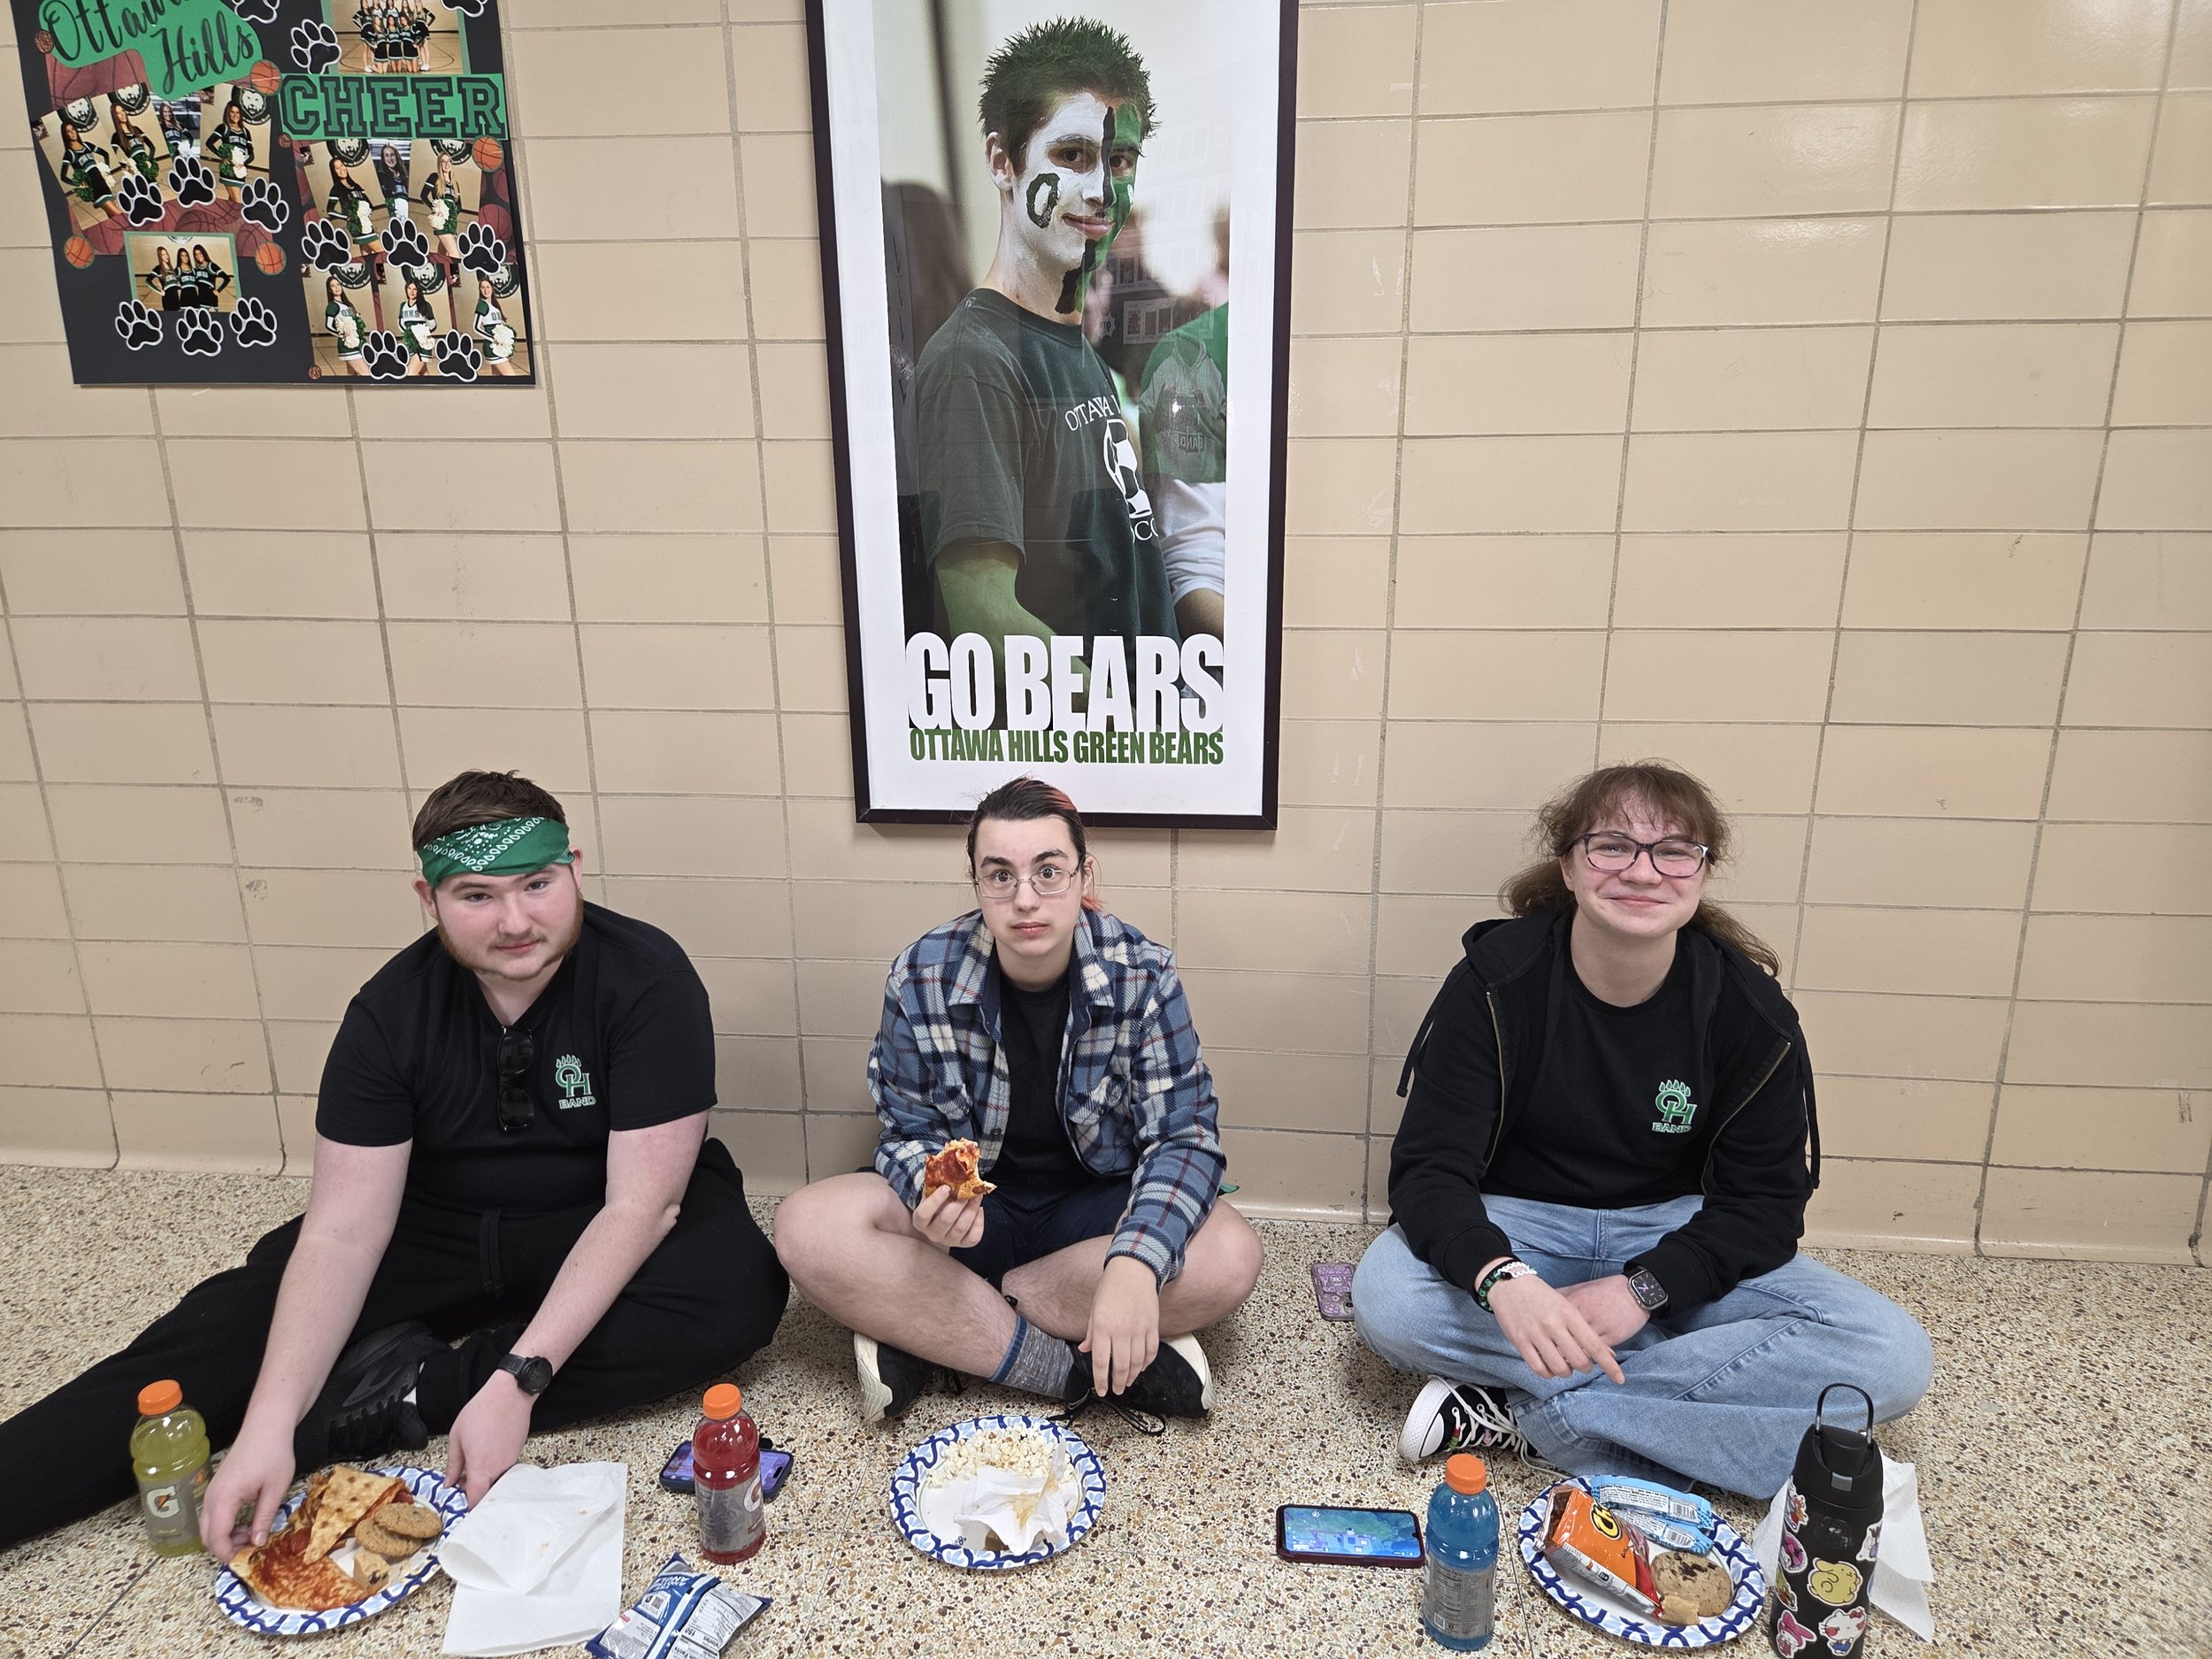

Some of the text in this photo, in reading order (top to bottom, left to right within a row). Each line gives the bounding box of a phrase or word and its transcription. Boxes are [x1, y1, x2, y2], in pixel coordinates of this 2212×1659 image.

[150, 11, 255, 95] Hills
[281, 74, 508, 138] CHEER
[905, 631, 1225, 732] GO BEARS
[910, 728, 1224, 765] OTTAWA HILLS GREEN BEARS
[555, 1063, 592, 1097] OH
[558, 1096, 596, 1110] BAND
[1655, 1088, 1698, 1125] OH
[1652, 1121, 1693, 1133] BAND
[146, 1486, 180, 1519] G
[684, 1626, 696, 1637] 150
